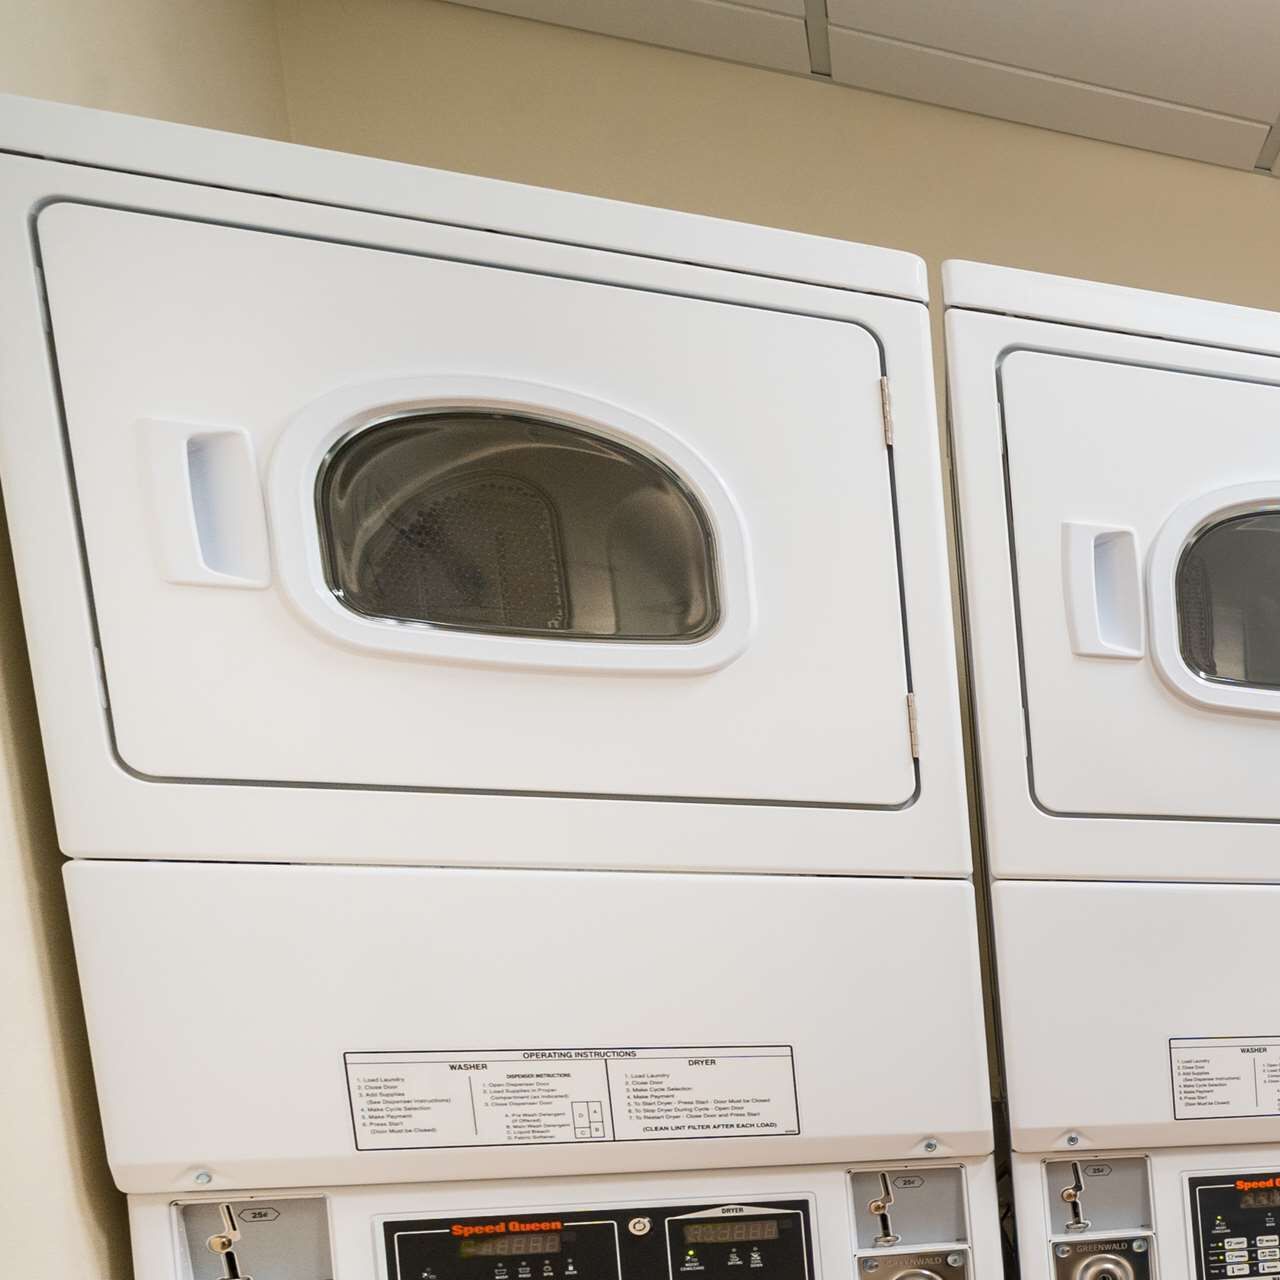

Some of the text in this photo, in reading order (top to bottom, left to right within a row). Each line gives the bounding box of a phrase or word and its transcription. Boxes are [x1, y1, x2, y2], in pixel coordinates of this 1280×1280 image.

[1236, 1179, 1274, 1190] Speed
[451, 1221, 563, 1237] Speed Queen
[1076, 1242, 1128, 1253] GREENWALD
